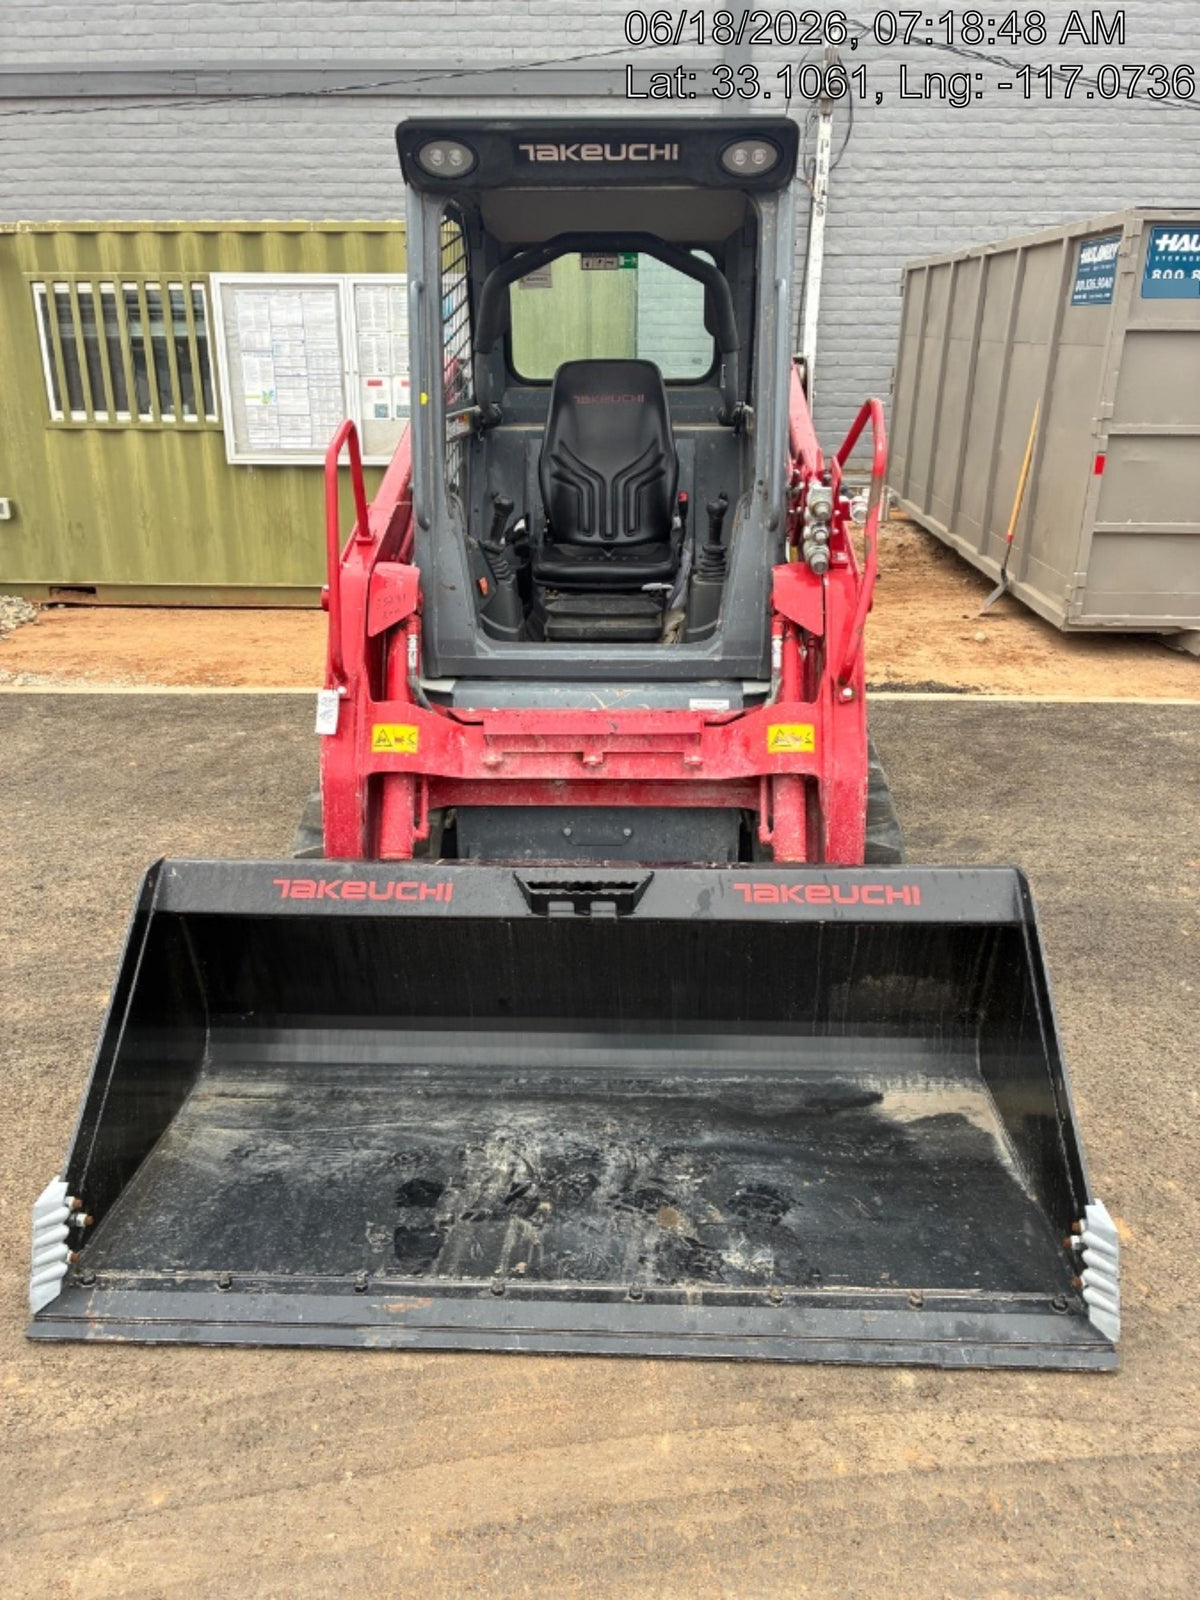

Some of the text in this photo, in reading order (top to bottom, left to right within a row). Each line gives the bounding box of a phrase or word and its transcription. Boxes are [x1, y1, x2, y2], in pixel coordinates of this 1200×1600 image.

[519, 143, 679, 162] TAKEUCHI
[272, 878, 453, 904] TAKEUCHI
[733, 882, 921, 906] TAKEUCHI
